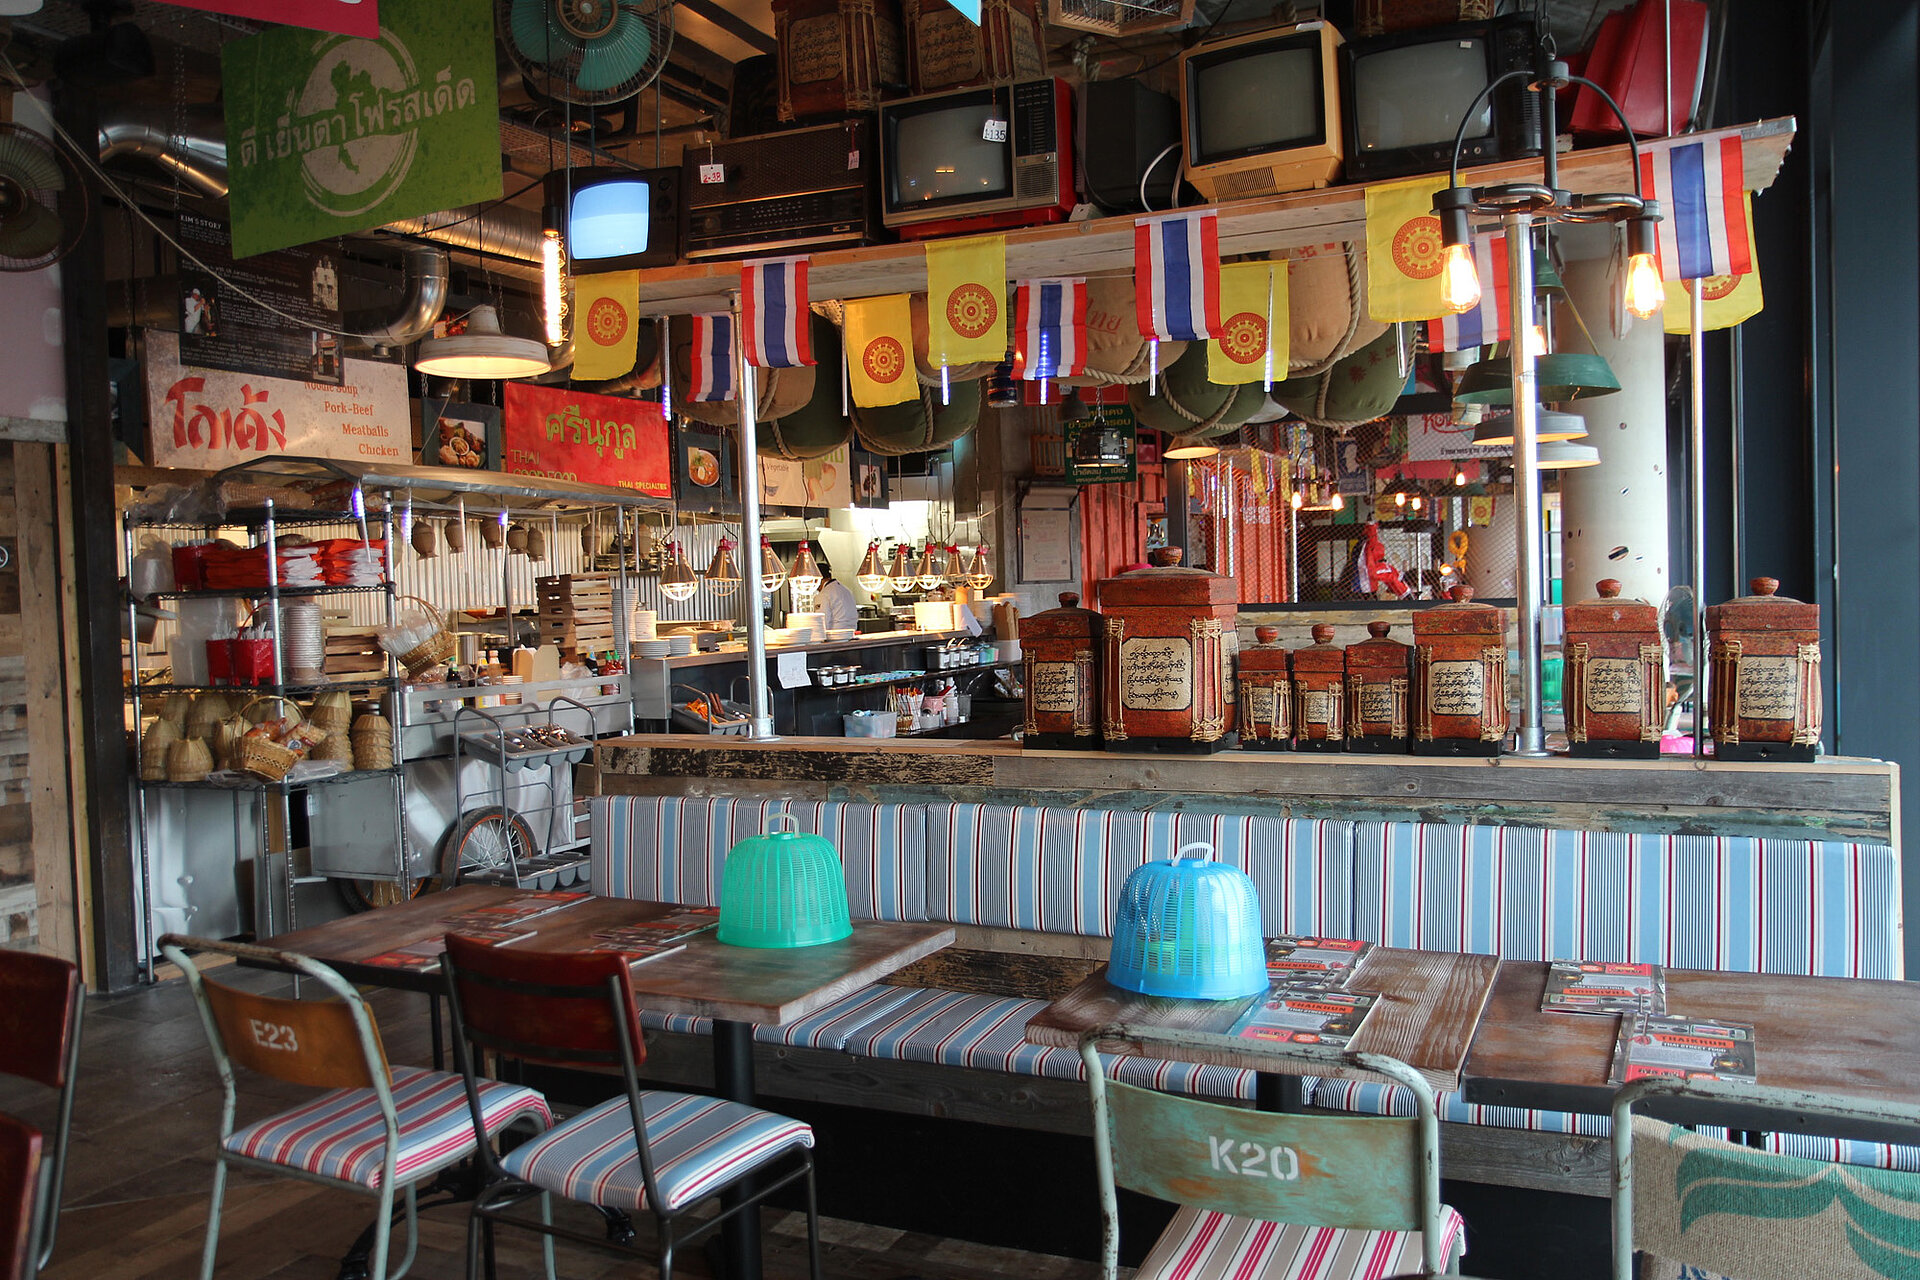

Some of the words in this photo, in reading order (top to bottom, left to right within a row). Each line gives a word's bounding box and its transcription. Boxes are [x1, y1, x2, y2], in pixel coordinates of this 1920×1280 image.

[324, 400, 374, 416] Pork-Beef
[342, 423, 389, 437] Meatballs
[359, 443, 399, 457] Chicken
[510, 449, 540, 465] THAI
[1291, 1000, 1347, 1012] THAIKHUN
[248, 1018, 299, 1052] E23
[1661, 1035, 1727, 1047] THAIKHUN
[1208, 1135, 1299, 1181] K20
